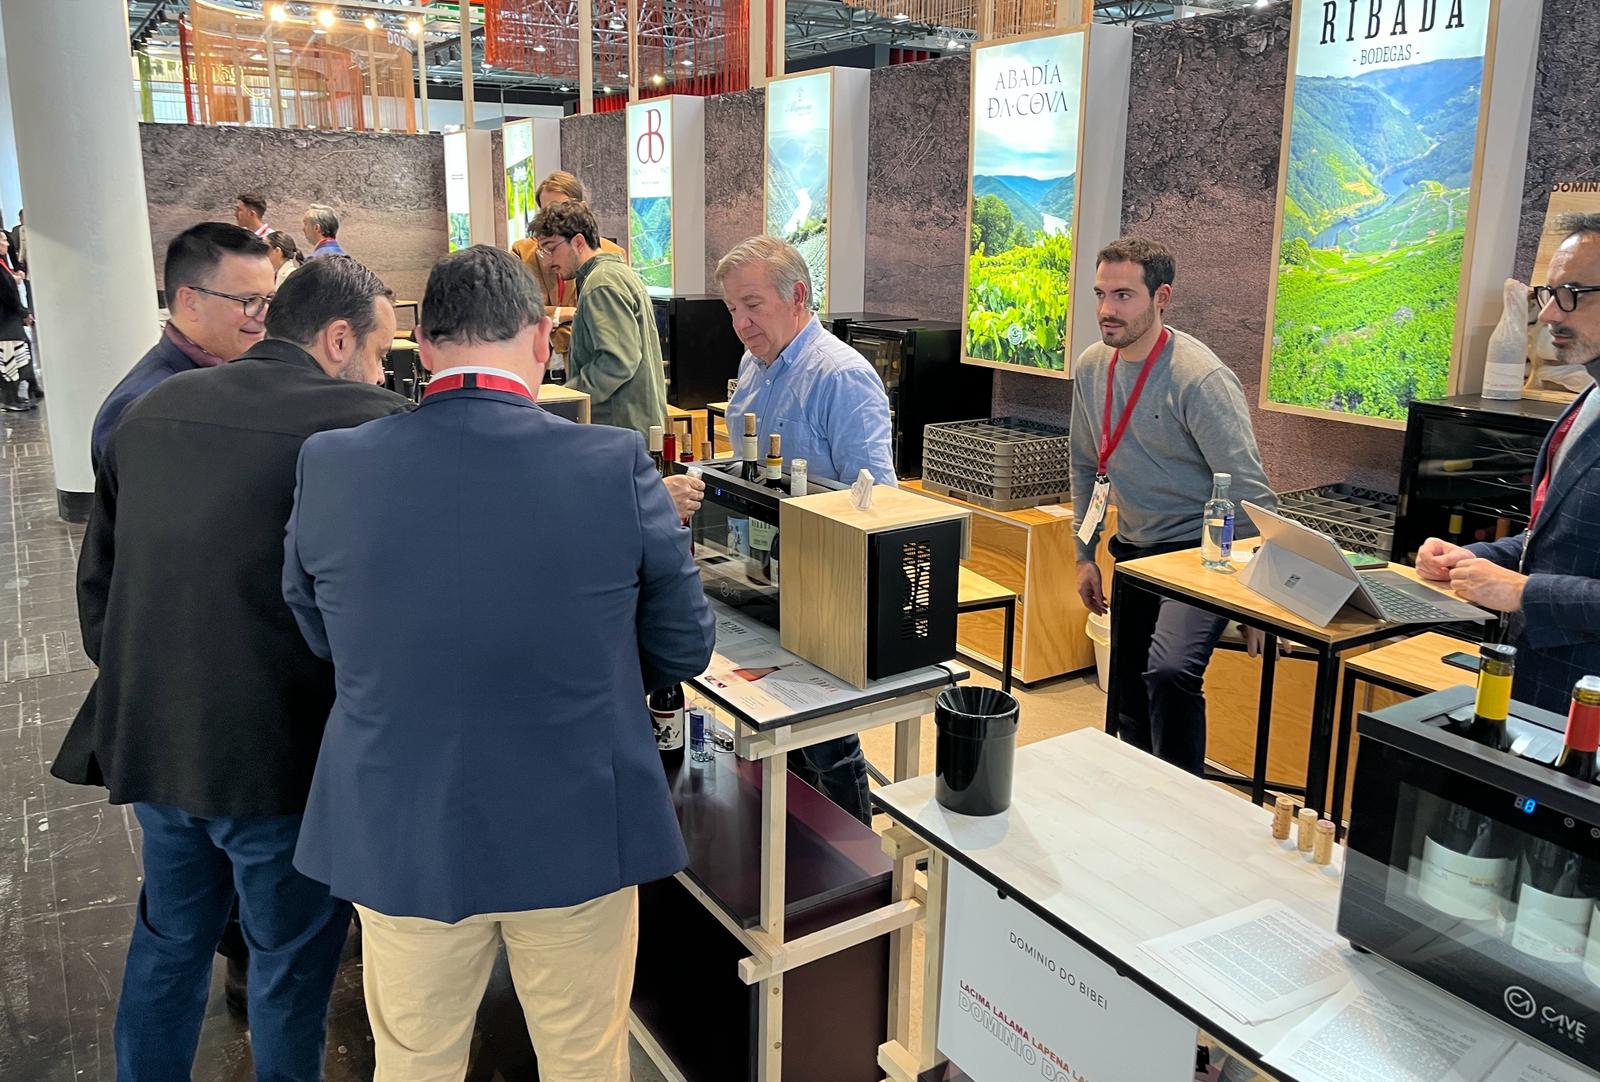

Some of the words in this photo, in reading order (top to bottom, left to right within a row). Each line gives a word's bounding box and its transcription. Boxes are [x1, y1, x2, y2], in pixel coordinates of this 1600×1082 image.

[1320, 0, 1464, 45] RIBADA
[1360, 44, 1412, 65] BODEGAS
[995, 59, 1062, 90] ABADÍA
[1552, 182, 1600, 192] DOMIN
[1009, 931, 1056, 972] DOMINIO
[1059, 967, 1076, 986] DO
[1079, 981, 1108, 1010] BIBEI
[958, 990, 1037, 1065] DOMINIO
[959, 979, 991, 1010] LACIMA
[993, 1005, 1029, 1041] LALAMA
[1031, 1037, 1070, 1073] LAPENA
[1541, 1006, 1587, 1039] CAVE
